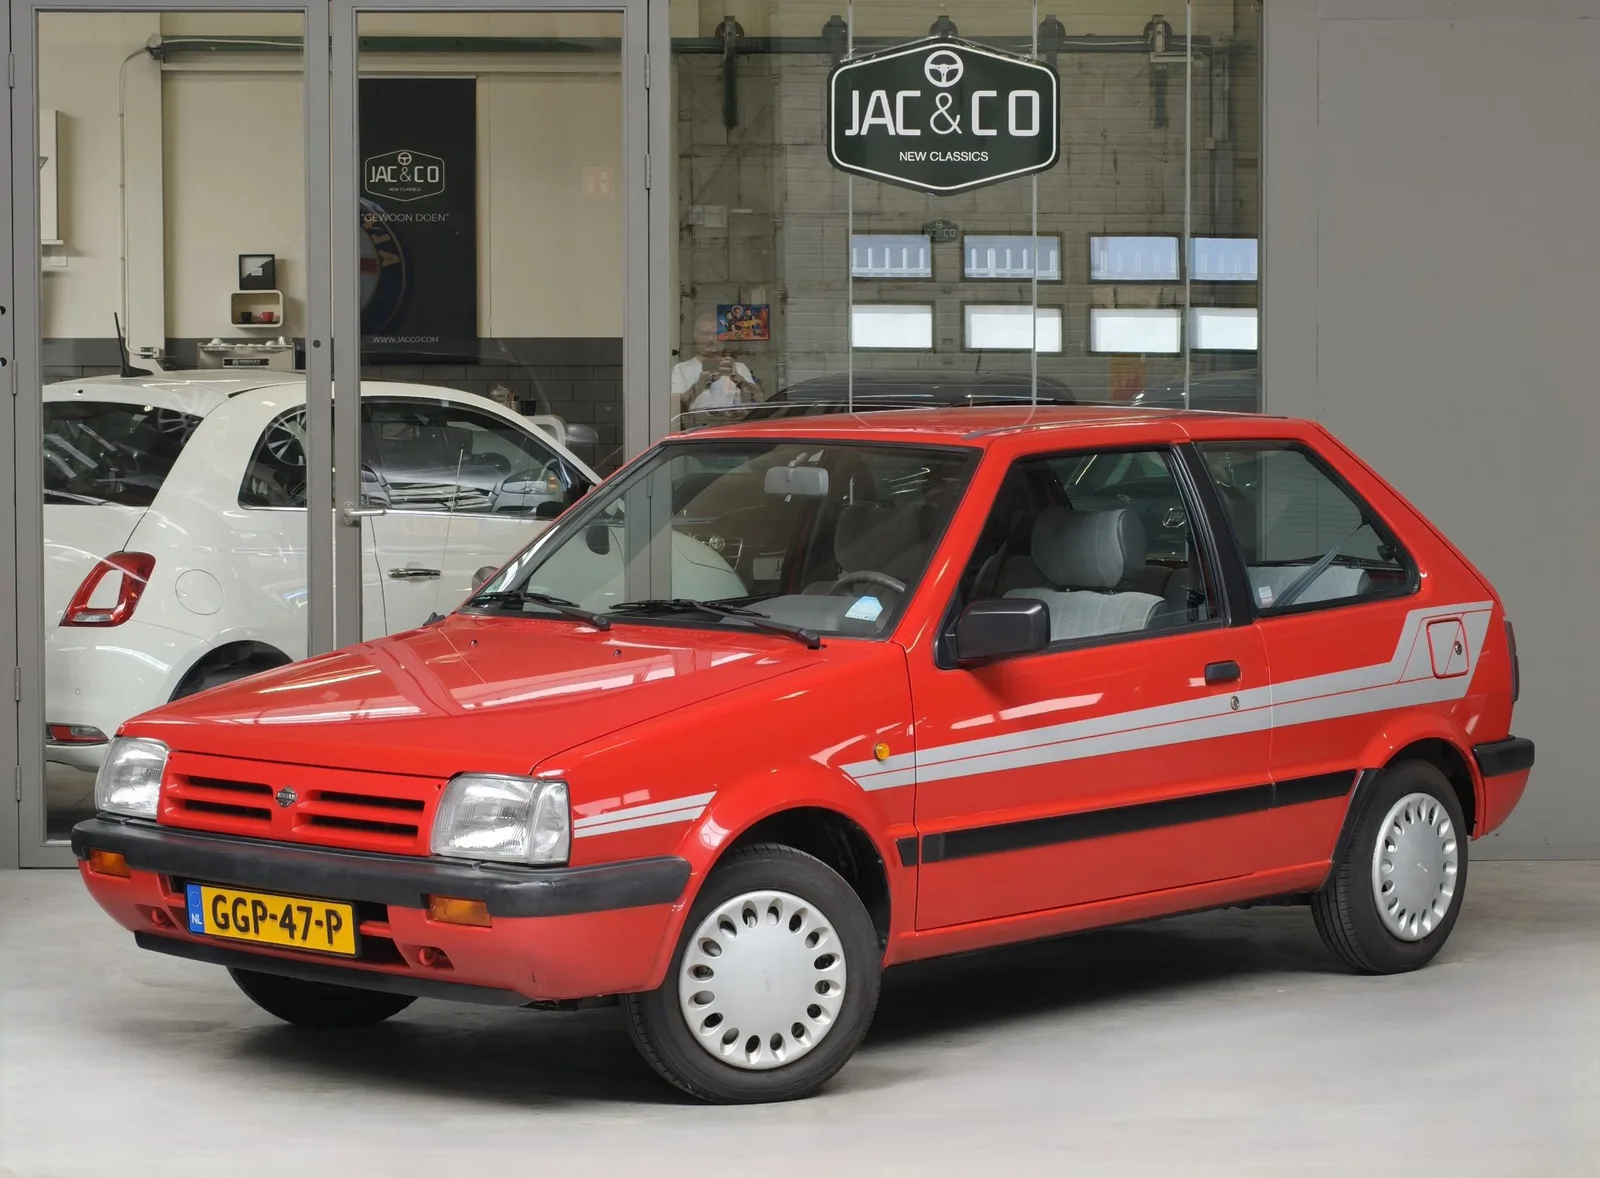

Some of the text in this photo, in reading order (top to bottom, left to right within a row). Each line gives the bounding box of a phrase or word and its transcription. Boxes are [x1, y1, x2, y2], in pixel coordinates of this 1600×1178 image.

[845, 90, 921, 136] JAC
[899, 151, 989, 162] NEW CLASSICS
[191, 912, 203, 925] NL
[211, 894, 343, 945] GGP-47-P
